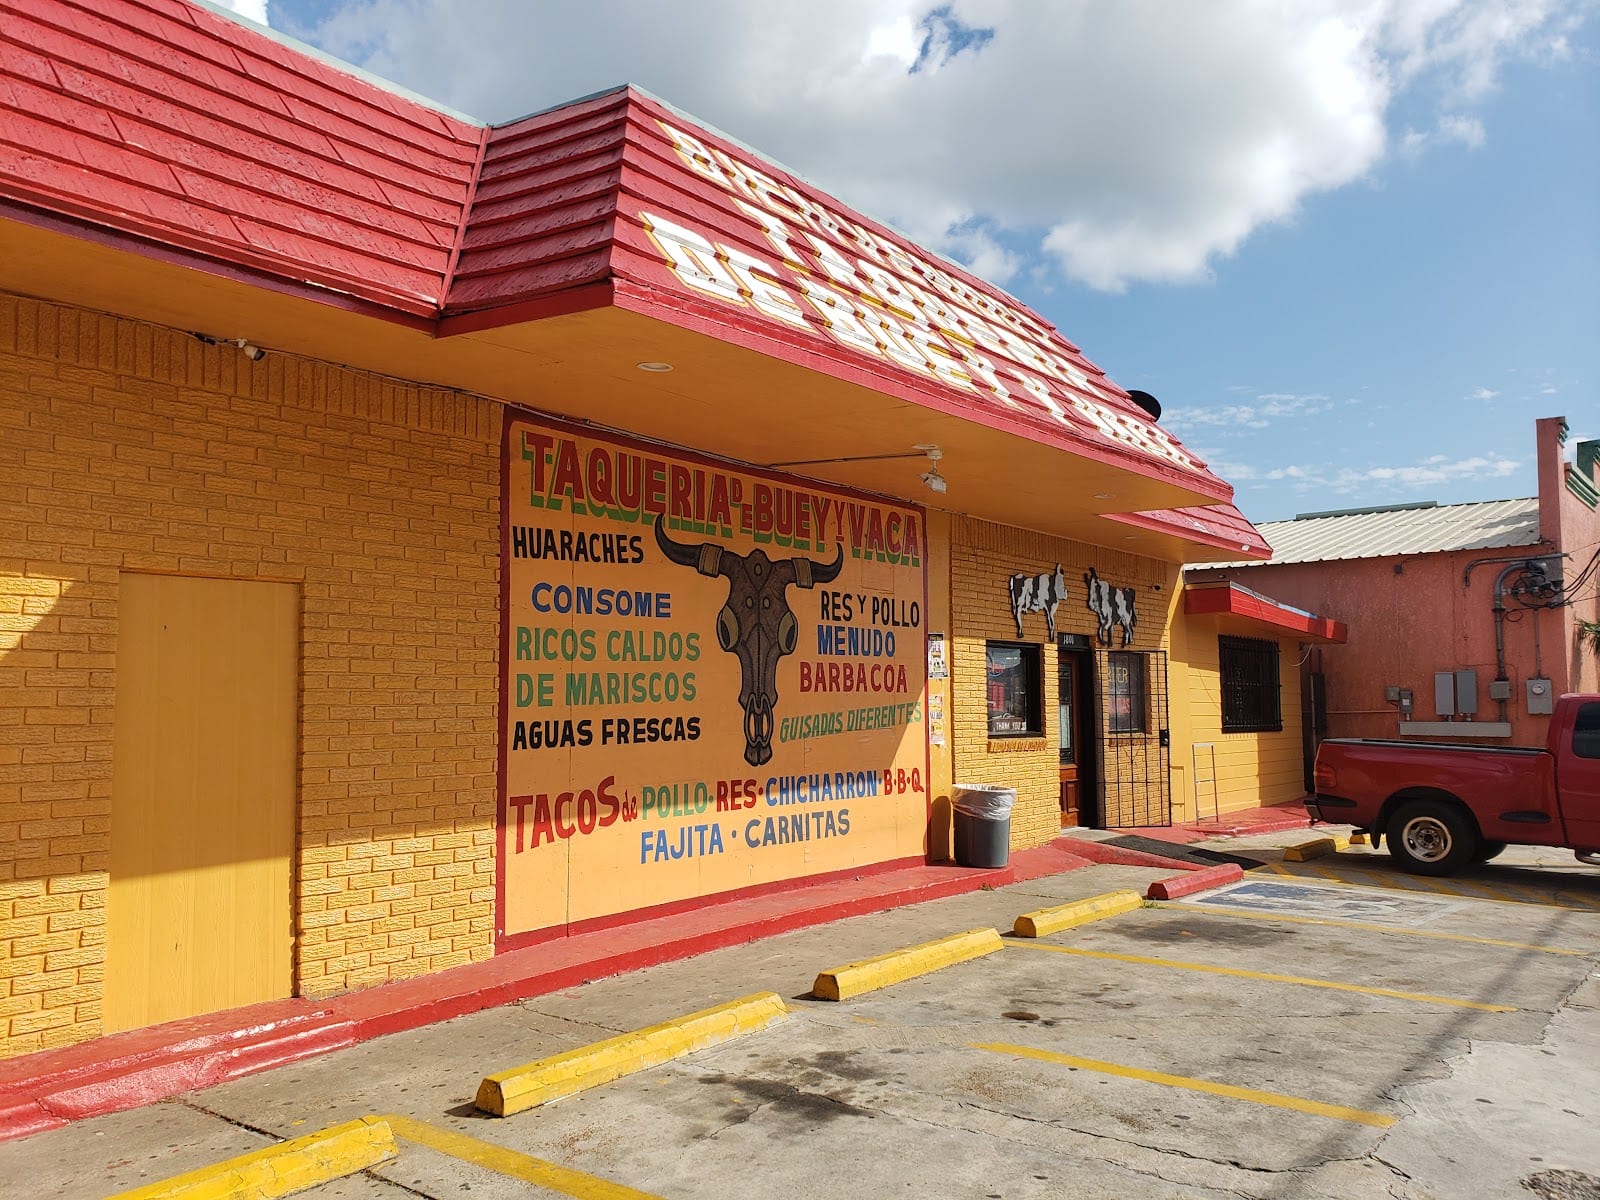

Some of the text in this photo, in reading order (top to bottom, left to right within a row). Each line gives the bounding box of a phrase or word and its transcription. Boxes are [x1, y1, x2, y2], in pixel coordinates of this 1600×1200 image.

[638, 210, 820, 336] DE
[794, 275, 1030, 412] BUEY
[522, 430, 733, 537] TAQUERIA
[754, 484, 834, 552] BUEY
[832, 499, 845, 542] Y
[846, 504, 920, 567] VACA
[512, 526, 644, 564] HUARACHES
[531, 582, 671, 618] CONSOME
[821, 590, 920, 628] RES Y POLLO
[516, 626, 700, 662] RICOS CALDOS
[817, 625, 896, 658] MENUDO
[516, 672, 697, 708] DE MARISCOS
[799, 662, 908, 693] BARBACOA
[512, 716, 701, 751] AGUAS FRESCAS
[779, 701, 922, 744] GUISADOS DIFERENTES
[510, 775, 621, 854] TACOS
[621, 789, 638, 823] de
[641, 782, 708, 820] POLLO
[716, 778, 758, 812] RES
[765, 769, 878, 807] CHICHARRON
[640, 808, 851, 864] FAJITA CARNITAS
